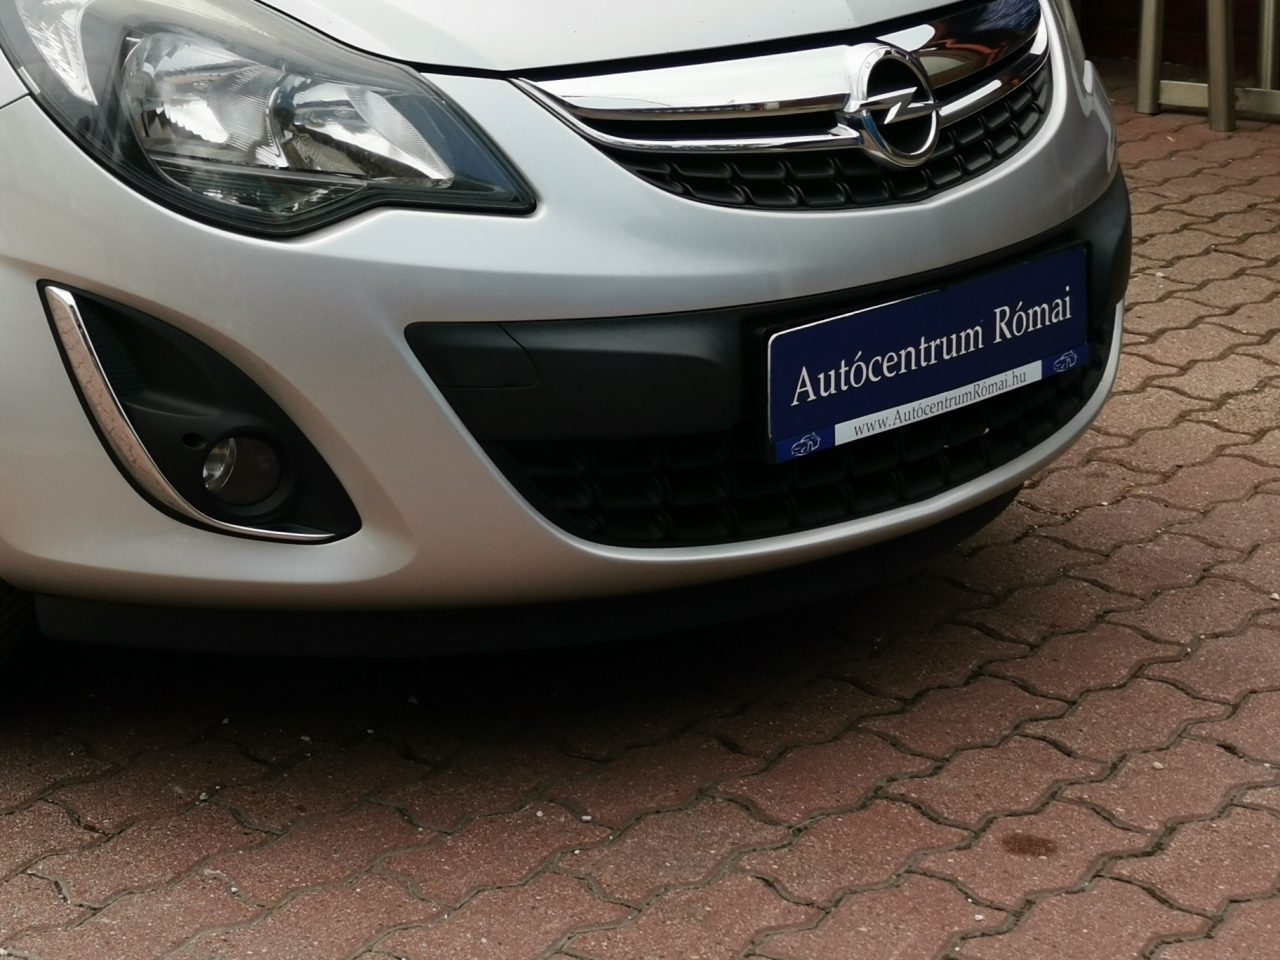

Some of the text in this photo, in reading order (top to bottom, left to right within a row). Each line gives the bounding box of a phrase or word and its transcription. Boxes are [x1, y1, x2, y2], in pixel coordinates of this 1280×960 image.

[790, 286, 1072, 407] Autócentrum Római
[853, 369, 1027, 437] www.AutócentrumRómai.hu
